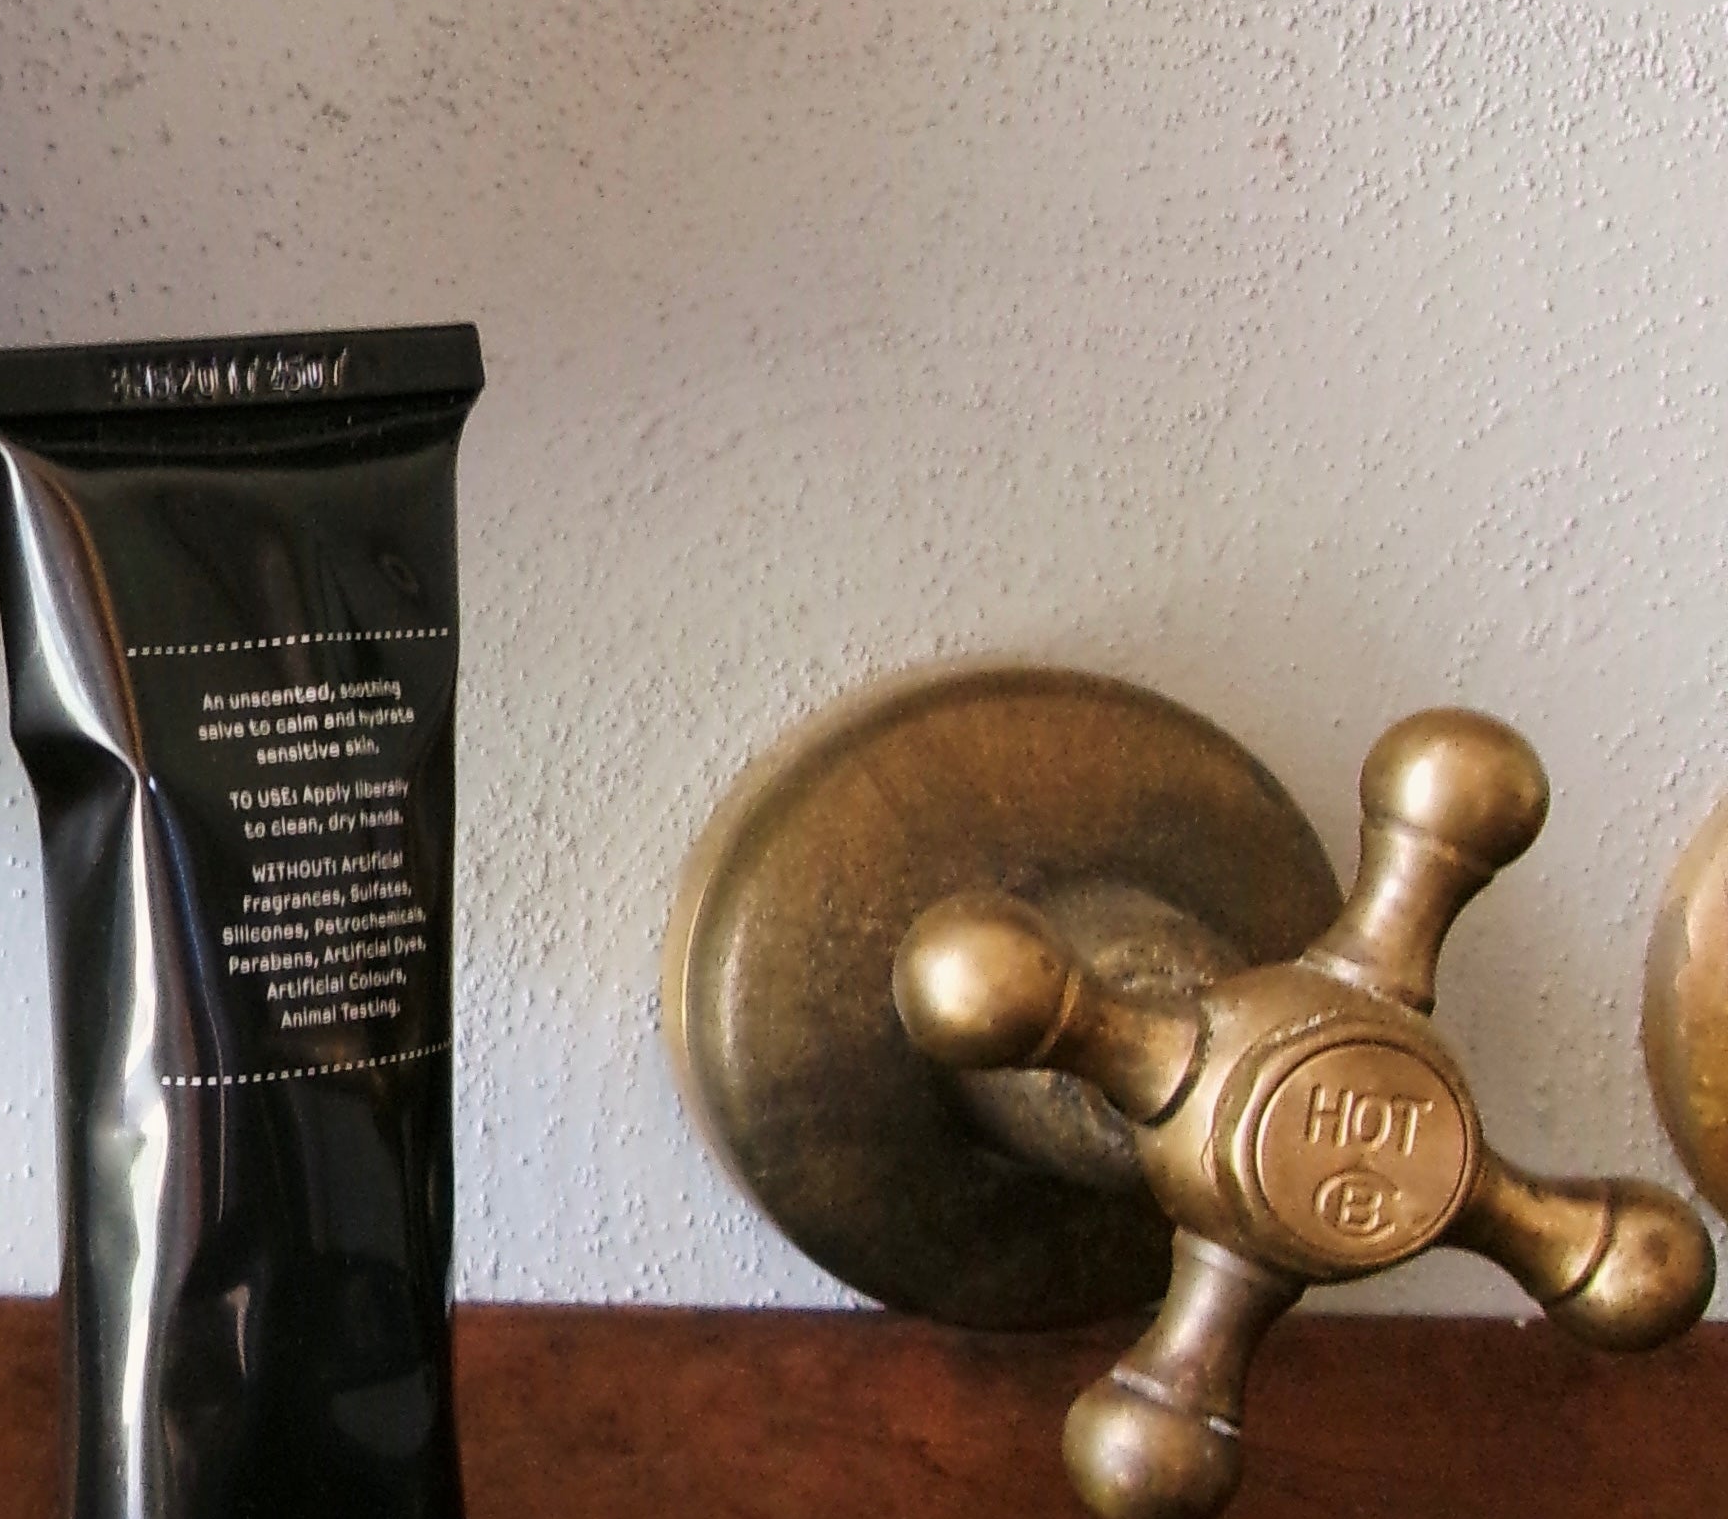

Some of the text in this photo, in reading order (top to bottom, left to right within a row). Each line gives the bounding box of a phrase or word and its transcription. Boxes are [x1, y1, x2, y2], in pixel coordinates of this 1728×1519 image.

[202, 677, 402, 712] An unscented, soothing
[198, 705, 416, 741] salve to calm and hydrate
[256, 739, 341, 766] sensitive
[228, 776, 410, 811] TO USE: Apply liberally
[244, 820, 266, 840] to
[271, 815, 324, 837] clean,
[328, 811, 356, 834] dry
[341, 849, 405, 875] Artificial
[242, 879, 413, 915] Fragrances, Sulfates,
[222, 922, 310, 946] Silicones,
[228, 951, 320, 977] Parabens,
[323, 936, 392, 965] Artificial
[266, 973, 345, 1001] Artificial
[280, 1004, 337, 1029] Animal
[1305, 1083, 1434, 1157] HOT
